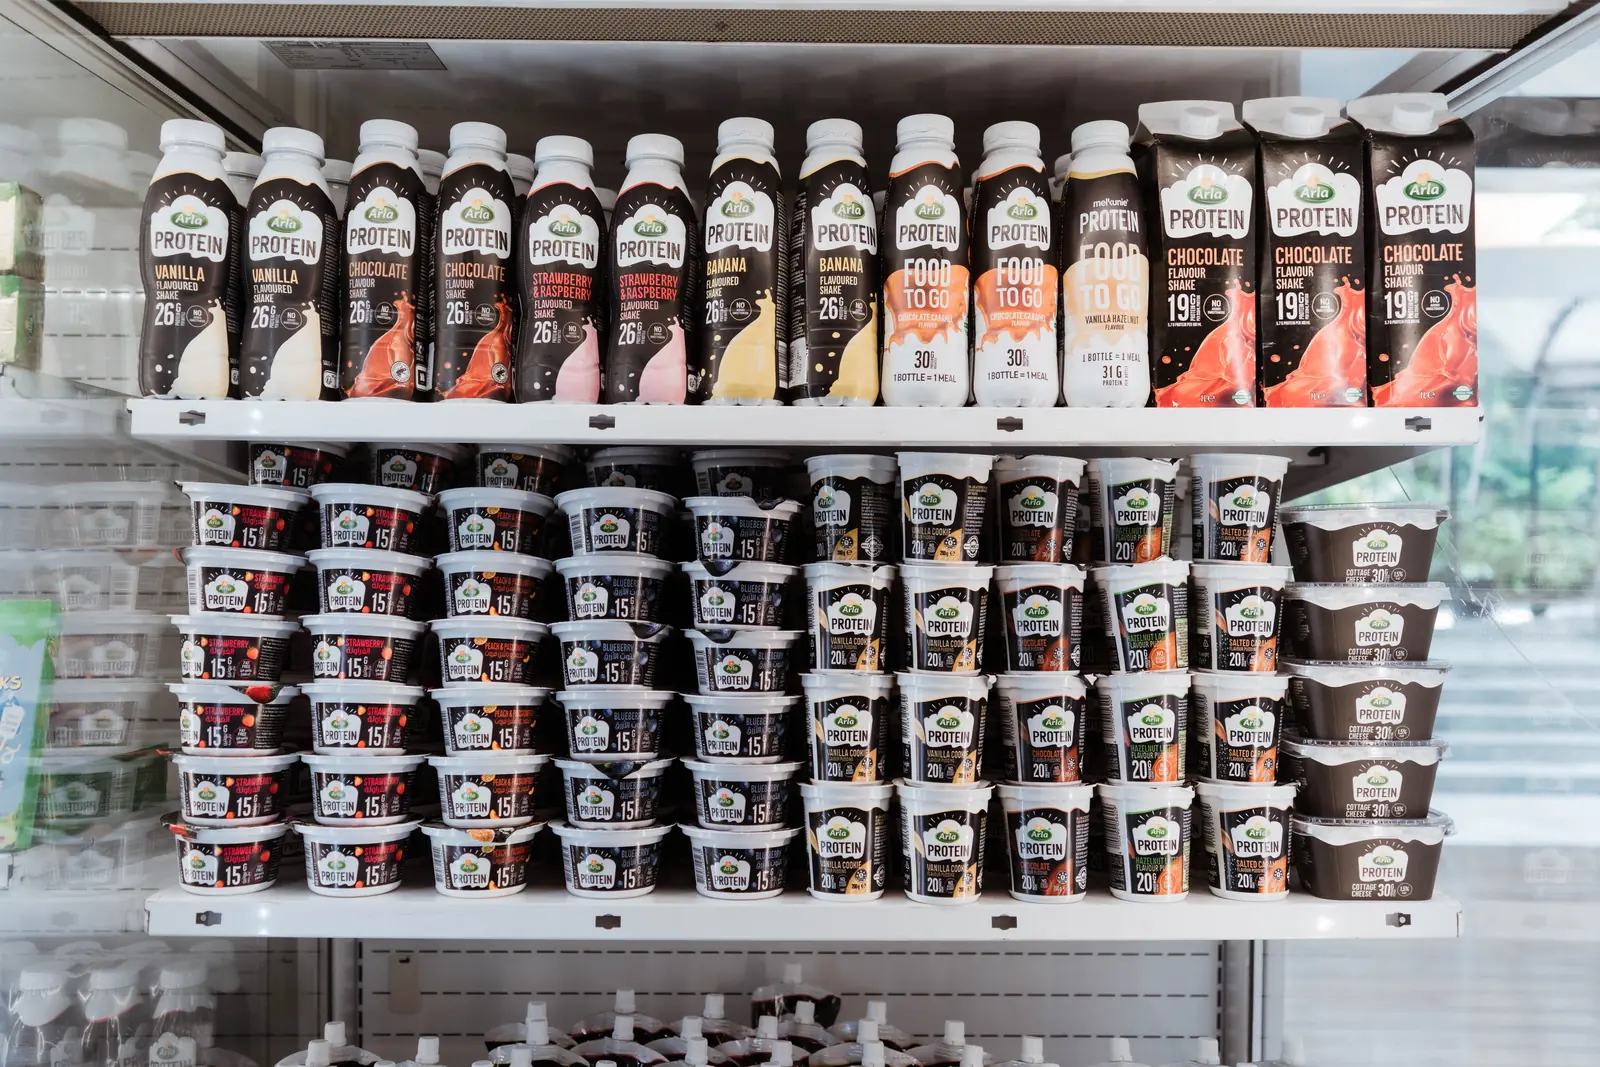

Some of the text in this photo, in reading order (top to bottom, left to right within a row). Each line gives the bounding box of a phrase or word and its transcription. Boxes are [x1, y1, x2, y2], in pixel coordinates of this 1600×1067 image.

[1193, 189, 1222, 200] Arla
[1300, 188, 1329, 199] Arla
[1409, 184, 1439, 196] Arla
[368, 208, 394, 220] Arla
[465, 209, 490, 220] Arla
[724, 204, 750, 215] Arla
[837, 205, 862, 216] Arla
[919, 205, 941, 216] Arla
[1011, 206, 1034, 216] Arla
[1385, 204, 1464, 226] PROTEIN
[175, 213, 203, 226] Arla
[271, 217, 297, 229] Arla
[1080, 210, 1139, 234] PROTEIN
[1170, 209, 1245, 229] PROTEIN
[1277, 207, 1353, 227] PROTEIN
[553, 222, 577, 234] Arla
[637, 222, 662, 234] Arla
[708, 223, 768, 245] PROTEIN
[900, 224, 957, 244] PROTEIN
[991, 224, 1048, 244] PROTEIN
[350, 227, 411, 250] PROTEIN
[446, 228, 508, 250] PROTEIN
[818, 224, 876, 247] PROTEIN
[155, 231, 222, 255] PROTEIN
[252, 236, 317, 258] PROTEIN
[533, 240, 594, 262] PROTEIN
[620, 240, 681, 261] PROTEIN
[1275, 247, 1352, 265] CHOCOLATE
[1384, 244, 1463, 263] CHOCOLATE
[1080, 242, 1141, 283] FOOD
[1168, 249, 1244, 266] CHOCOLATE
[349, 262, 407, 280] CHOCOLATE
[706, 257, 747, 276] BANANA
[820, 258, 863, 273] BANANA
[997, 257, 1044, 287] FOOD
[1385, 265, 1423, 276] FLAVOUR
[155, 265, 205, 282] VANILLA
[252, 269, 298, 284] VANILLA
[445, 263, 504, 282] CHOCOLATE
[904, 258, 951, 287] FOOD
[1169, 267, 1206, 279] FLAVOUR
[156, 281, 198, 292] FLAVOURED
[350, 279, 375, 288] FLAVOUR
[533, 273, 592, 288] STRAWBERRY
[620, 274, 678, 288] STRAWBERRY
[820, 276, 858, 286] FLAVOURED
[1168, 280, 1195, 290] SHAKE
[1385, 277, 1413, 288] SHAKE
[156, 291, 179, 300] SHAKE
[254, 284, 292, 294] FLAVOURED
[350, 288, 367, 298] SHAKE
[540, 286, 591, 300] RASPBERRY
[627, 286, 678, 300] RASPBERRY
[820, 286, 841, 295] SHAKE
[904, 289, 949, 309] TO GO
[997, 288, 1042, 308] TO GO
[1080, 284, 1141, 311] TO GO
[534, 300, 572, 309] FLAVOURED
[621, 301, 658, 311] FLAVOURED
[820, 297, 838, 319] 26
[1168, 294, 1189, 322] 19
[1276, 292, 1297, 320] 19
[1385, 291, 1406, 319] 19
[155, 302, 174, 325] 26
[251, 306, 269, 329] 26
[350, 301, 364, 324] 26
[447, 302, 464, 325] 26
[534, 310, 555, 318] SHAKE
[706, 301, 719, 324] 26
[1085, 315, 1138, 324] VANILLA HAZELNUT
[533, 321, 551, 344] 26
[618, 322, 636, 345] 26
[914, 351, 930, 369] 30
[1007, 349, 1022, 367] 30
[1088, 352, 1112, 361] BOTTLE
[1103, 365, 1121, 378] 31 G
[939, 374, 956, 383] MEAL
[256, 469, 282, 479] PROTEIN
[292, 468, 307, 486] 15
[815, 509, 846, 522] PROTEIN
[912, 508, 952, 521] PROTEIN
[1013, 511, 1054, 523] PROTEIN
[1223, 509, 1265, 523] PROTEIN
[334, 530, 365, 541] PROTEIN
[462, 534, 492, 544] PROTEIN
[594, 534, 626, 545] PROTEIN
[1356, 552, 1397, 563] PROTEIN
[1346, 569, 1370, 577] COTTAGE
[208, 595, 244, 605] PROTEIN
[615, 599, 628, 618] 15
[842, 606, 860, 614] Arla
[1028, 608, 1046, 616] Arla
[831, 618, 873, 631] PROTEIN
[1017, 620, 1059, 632] PROTEIN
[1127, 616, 1166, 628] PROTEIN
[209, 639, 249, 648] STRAWBERRY
[1229, 639, 1249, 647] SALTED
[1358, 632, 1399, 642] PROTEIN
[603, 643, 634, 652] BLUEBERRY
[1130, 650, 1144, 668] 20
[211, 658, 225, 678] 15
[315, 662, 338, 672] PROTEIN
[204, 706, 245, 717] STRAWBERRY
[1359, 709, 1400, 720] PROTEIN
[207, 727, 221, 746] 15
[458, 734, 489, 744] PROTEIN
[827, 729, 868, 742] PROTEIN
[928, 730, 970, 743] PROTEIN
[1133, 728, 1172, 738] PROTEIN
[927, 750, 949, 758] VANILLA
[1032, 750, 1062, 758] CHOCOLATE
[1132, 760, 1147, 779] 20
[235, 777, 273, 786] STRAWBERRY
[821, 842, 861, 854] PROTEIN
[1020, 843, 1062, 854] PROTEIN
[1237, 842, 1279, 853] PROTEIN
[1236, 860, 1257, 868] SALTED
[321, 871, 355, 882] PROTEIN
[1362, 867, 1403, 877] PROTEIN
[714, 876, 747, 887] PROTEIN
[1137, 872, 1152, 892] 20
